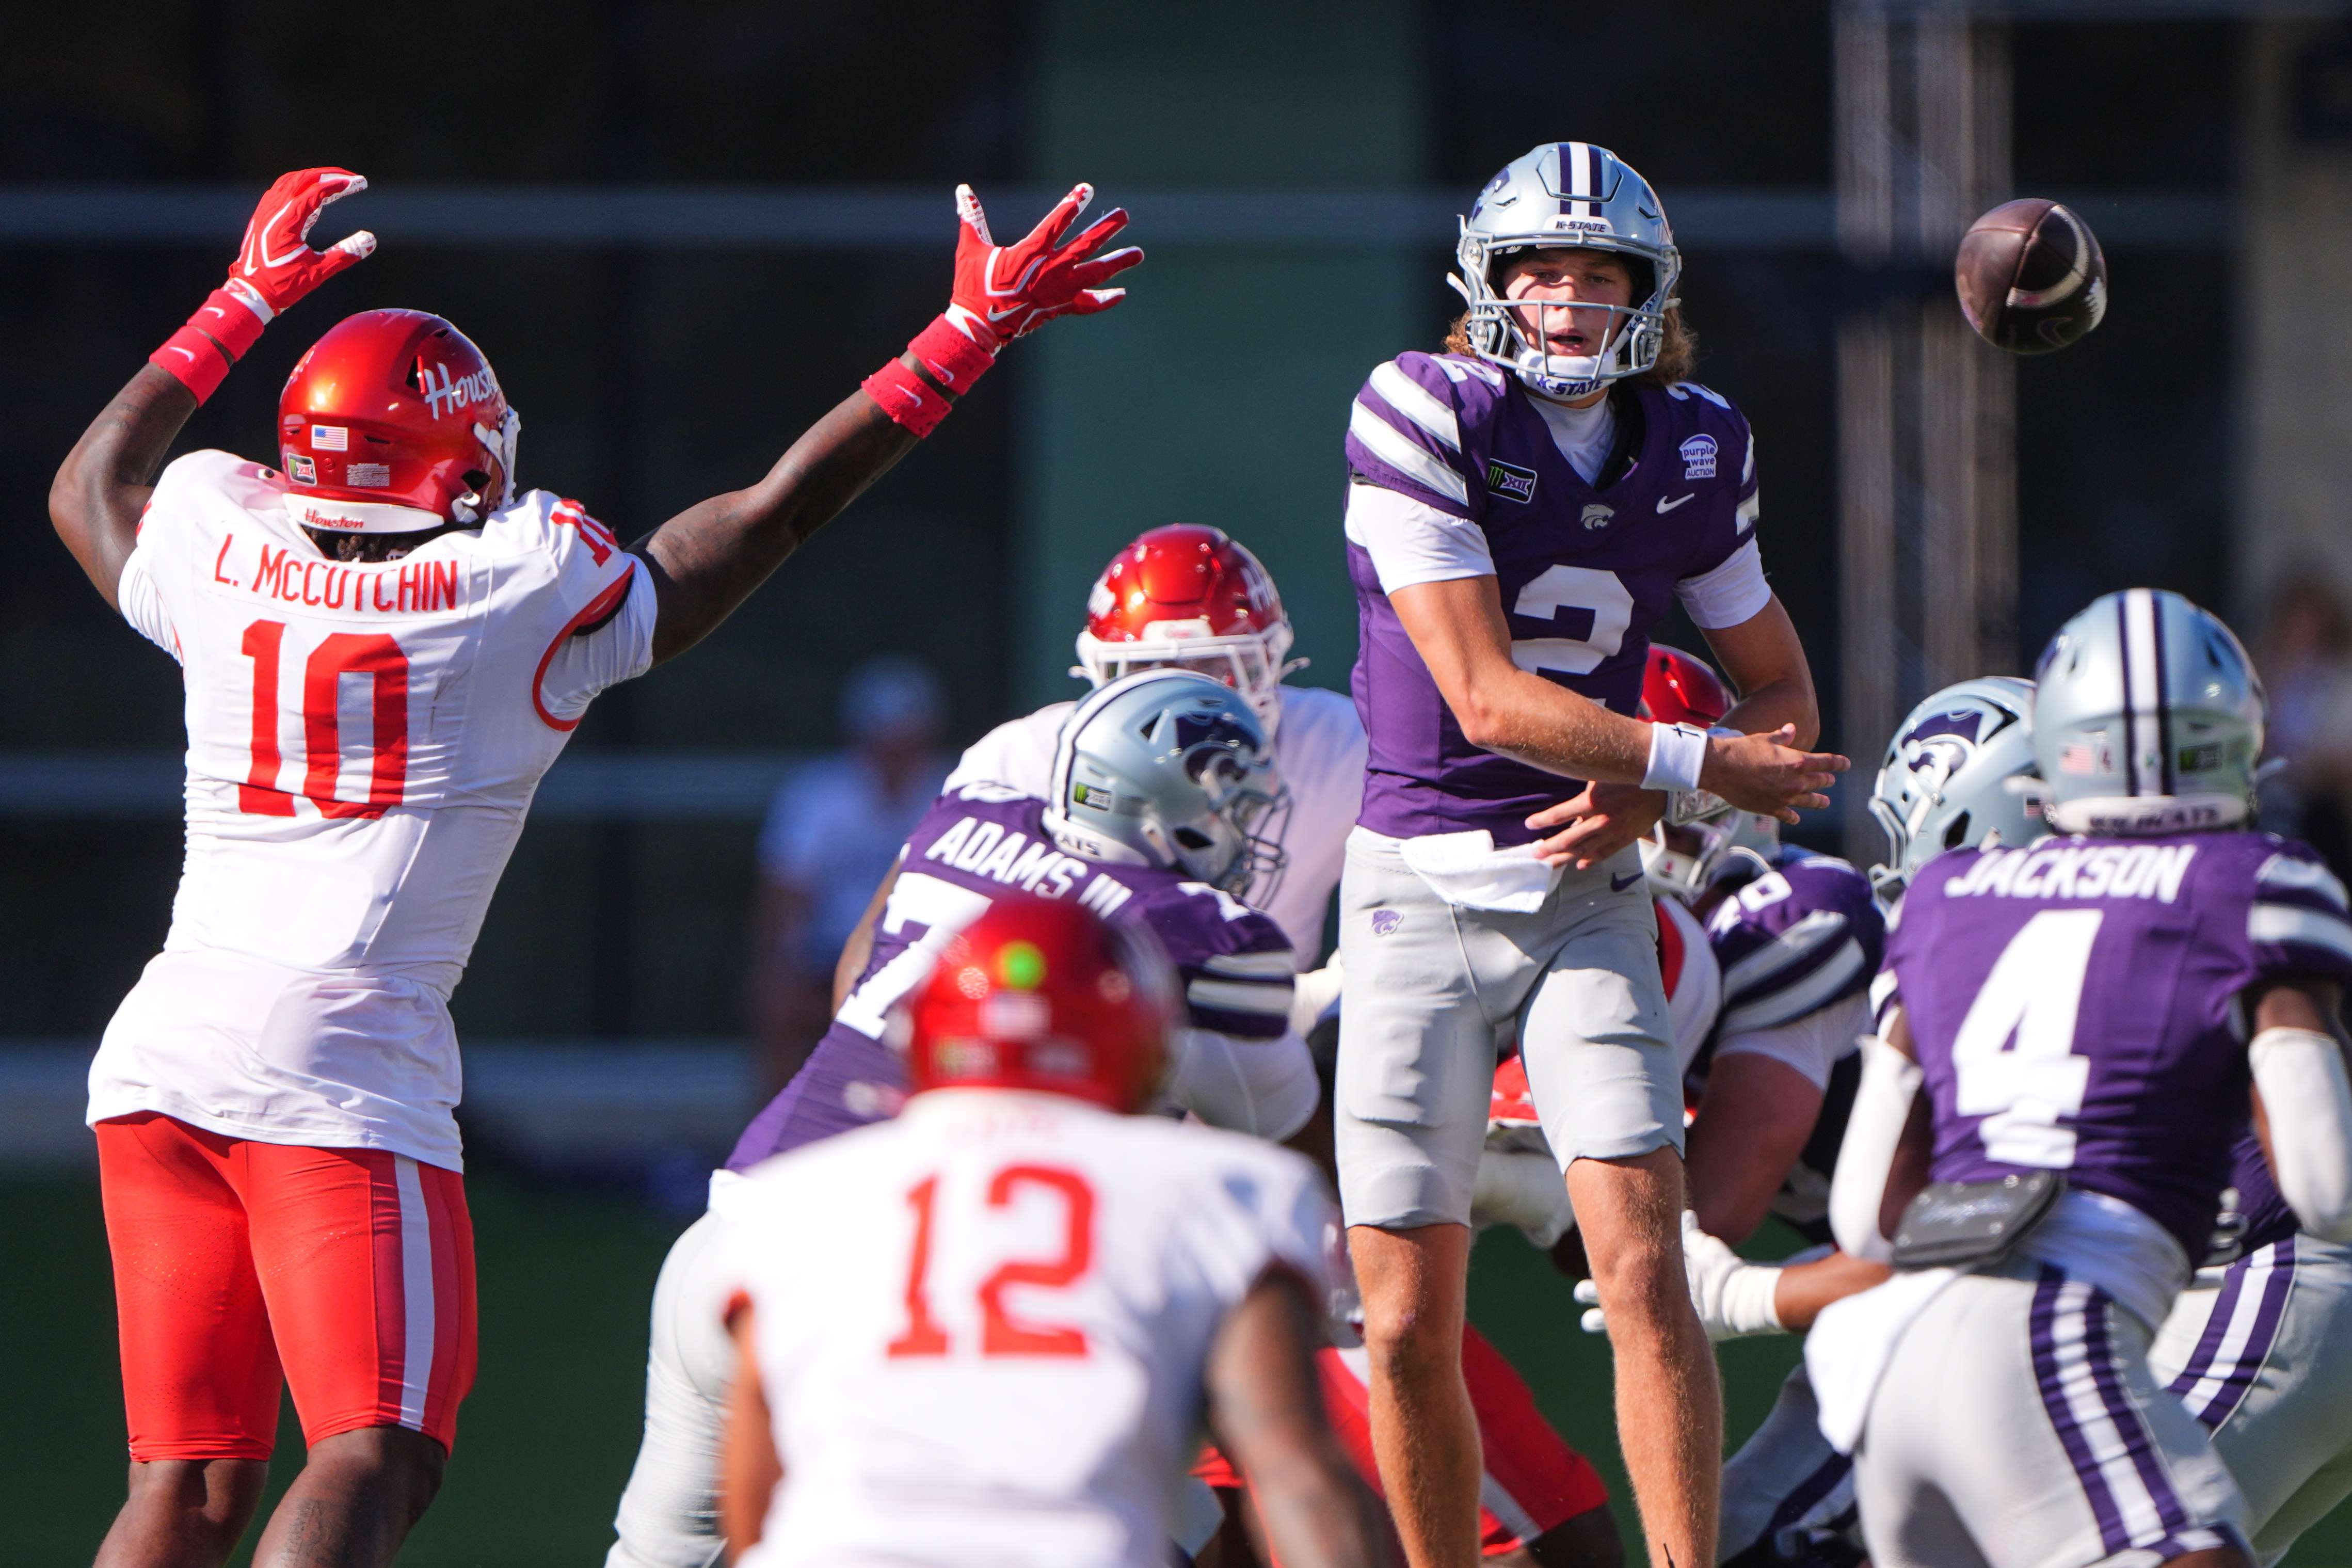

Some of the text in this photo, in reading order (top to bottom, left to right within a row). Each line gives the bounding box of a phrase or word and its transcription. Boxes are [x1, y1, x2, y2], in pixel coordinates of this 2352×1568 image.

[1555, 220, 1607, 232] K-STATE
[1537, 374, 1603, 396] K-STATE
[1683, 444, 1715, 459] purple
[1687, 468, 1715, 476] AUCTION
[1691, 458, 1715, 467] wave
[303, 507, 364, 529] Houston
[215, 533, 238, 587] L.
[1512, 564, 1635, 708] 2
[238, 619, 409, 820] 10
[924, 817, 1089, 900] ADAMS
[1077, 872, 1135, 920] III
[1943, 843, 2198, 904] JACKSON
[1951, 908, 2104, 1169] 4
[885, 1162, 1097, 1357] 12
